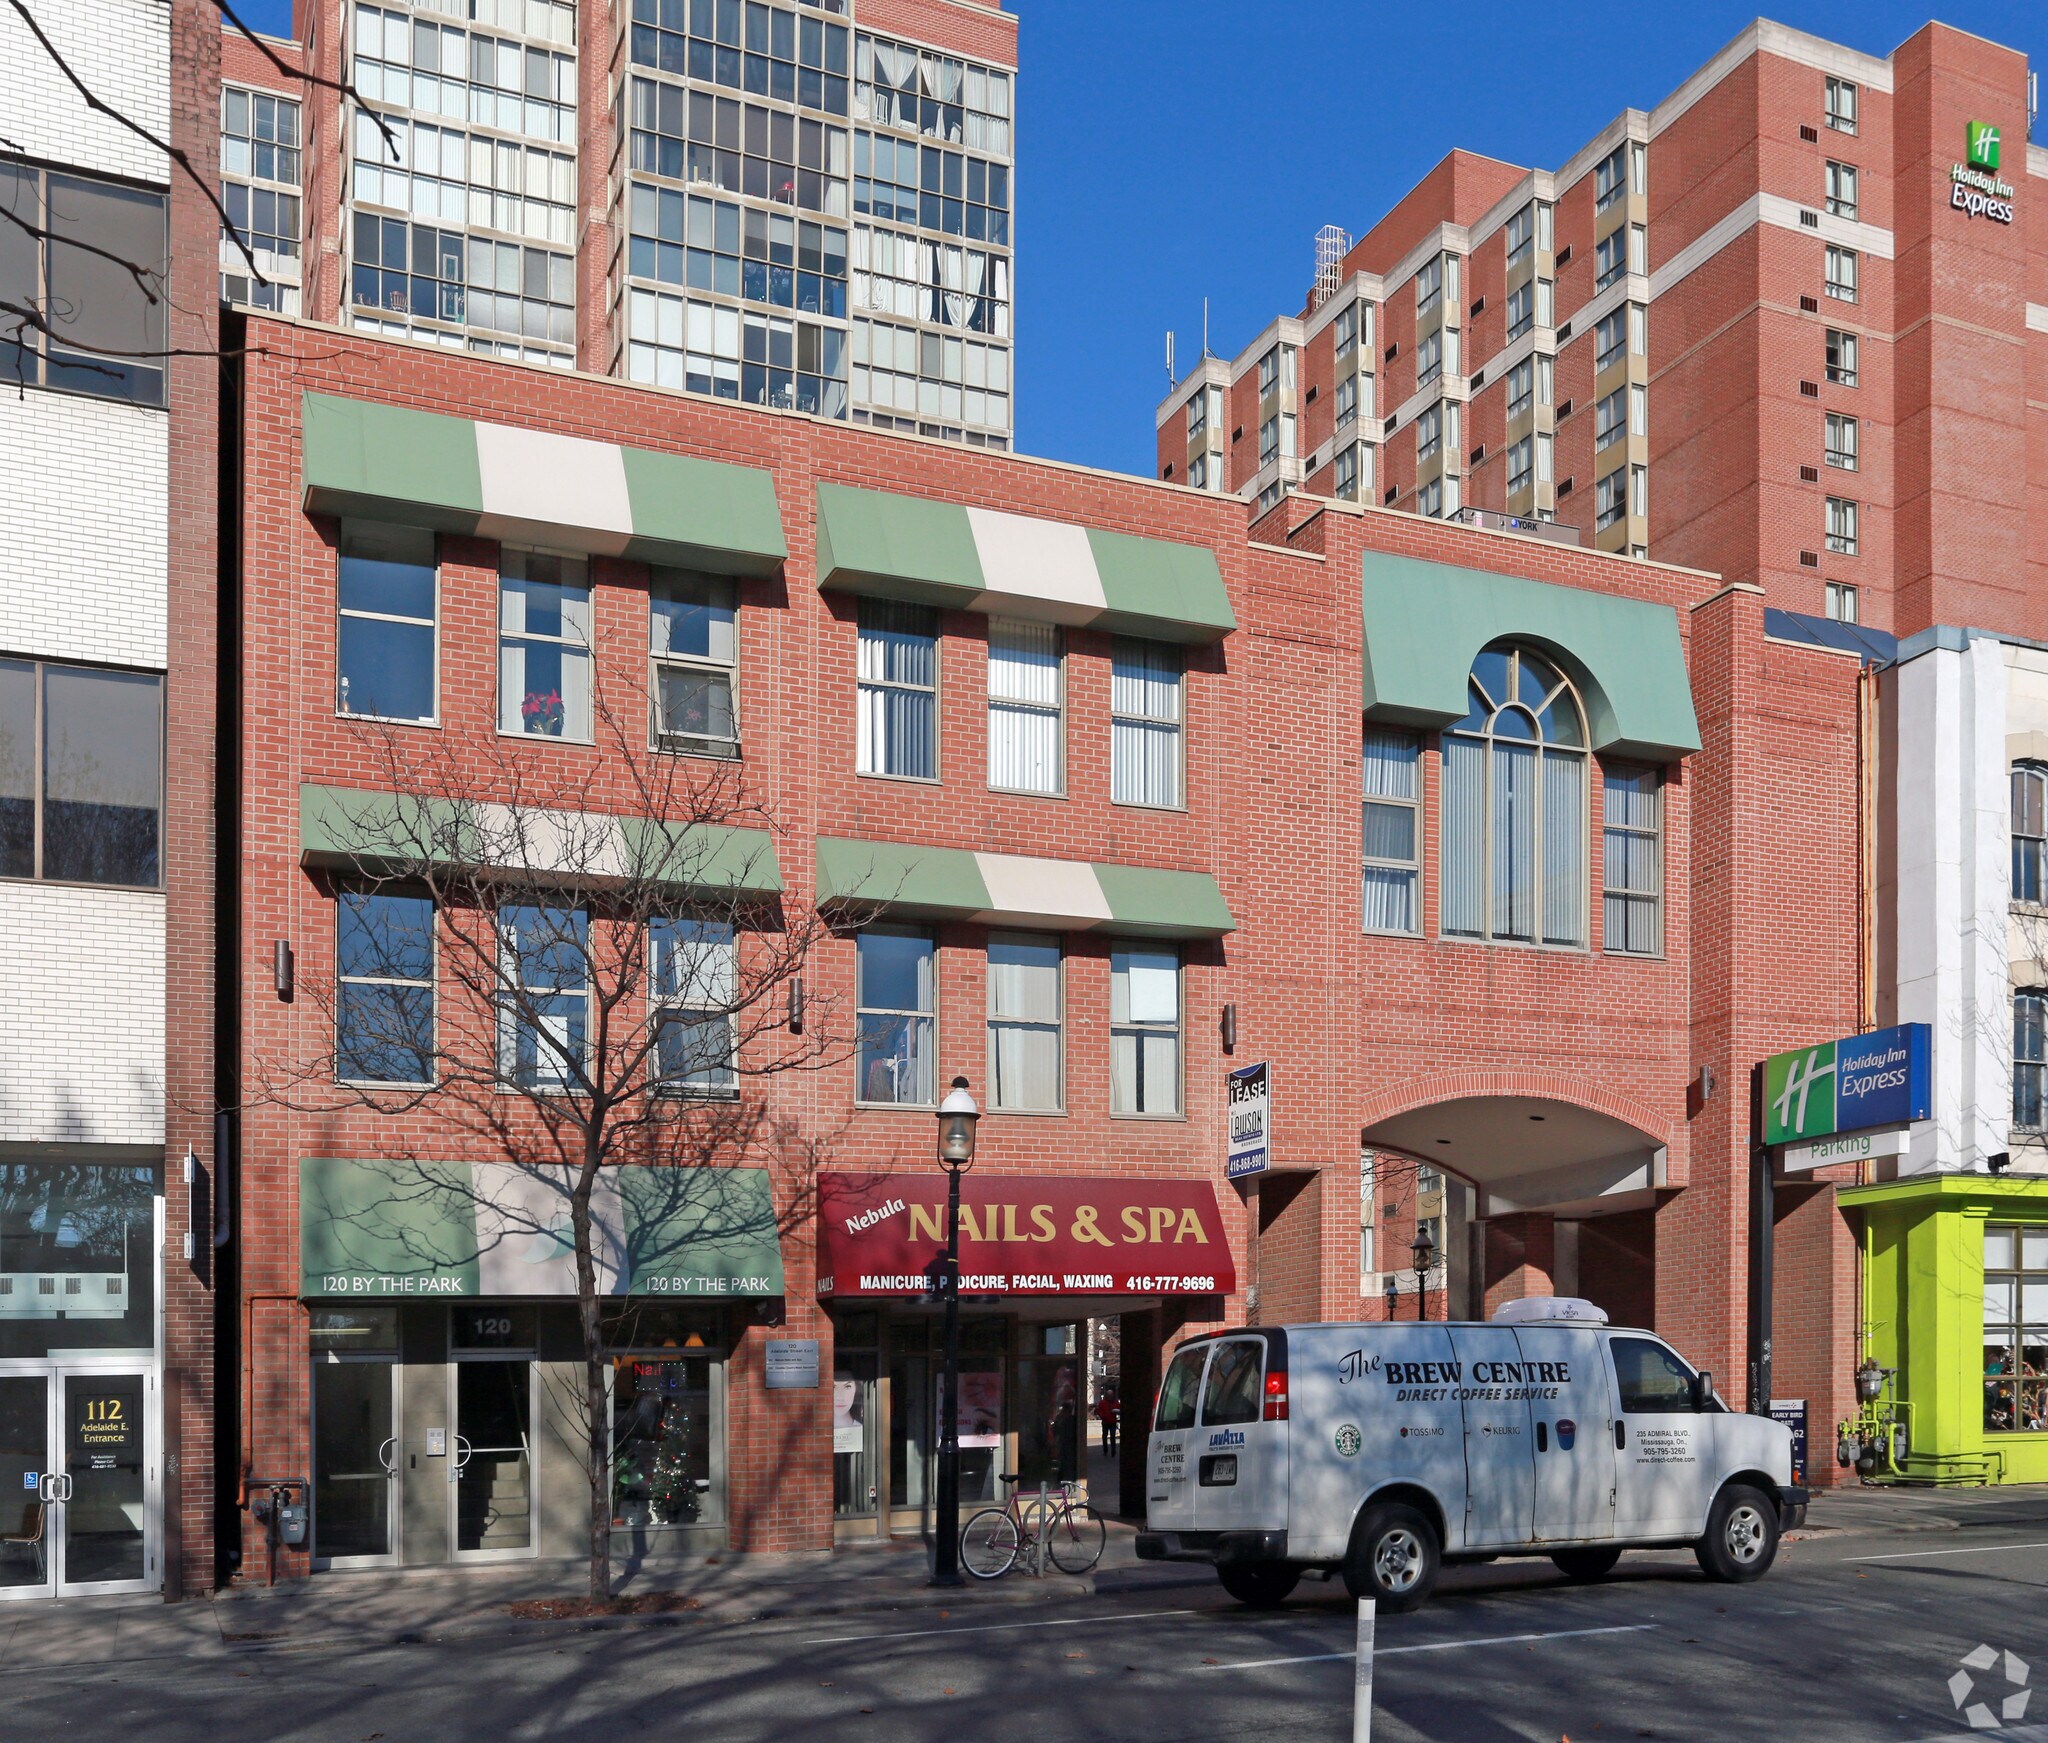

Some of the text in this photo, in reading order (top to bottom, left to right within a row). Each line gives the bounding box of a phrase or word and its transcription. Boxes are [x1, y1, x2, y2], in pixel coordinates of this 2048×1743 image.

[1952, 164, 2013, 196] Holiday Inn
[1952, 183, 2013, 222] Express
[1518, 520, 1538, 532] YORK
[1842, 1048, 1906, 1072] Holiday Inn
[1231, 1079, 1242, 1090] FOR
[1842, 1068, 1906, 1098] Express
[1231, 1080, 1264, 1104] LEASE
[1230, 1109, 1262, 1139] LAWSON
[1812, 1136, 1871, 1159] Parking
[844, 1198, 906, 1235] Nebula
[908, 1203, 1210, 1247] NAILS & SPA
[323, 1276, 463, 1292] 120 BY THE PARK
[646, 1276, 770, 1291] 120 BY THE PARK
[817, 1276, 834, 1293] NAILS
[860, 1274, 1214, 1292] MANICURE, PDICURE, FACIAL, WAXING 416-777-9696
[474, 1318, 511, 1334] 120
[1338, 1348, 1382, 1384] The
[1384, 1362, 1572, 1384] BREW CENTRE
[1396, 1388, 1558, 1401] DIRECT COFFEE SERVICE
[87, 1399, 122, 1420] 112
[80, 1422, 129, 1432] Adelaide E.
[1410, 1428, 1444, 1436] TOSSIMO
[1493, 1426, 1520, 1434] KEURIG
[84, 1434, 125, 1443] Entrance
[1209, 1429, 1245, 1446] LAVAZZA
[1164, 1444, 1182, 1453] BREW
[1161, 1454, 1185, 1463] CENTRE
